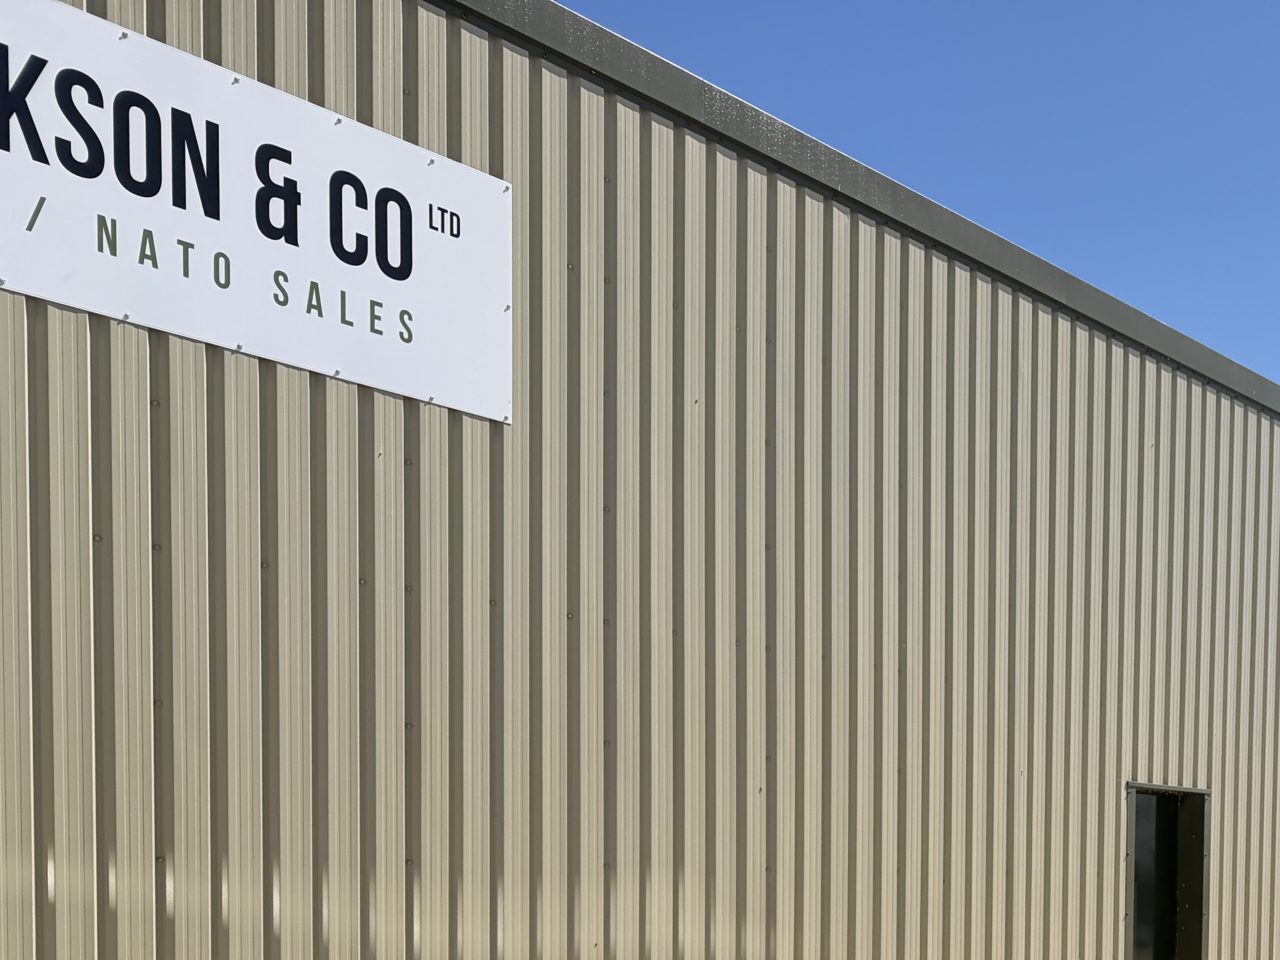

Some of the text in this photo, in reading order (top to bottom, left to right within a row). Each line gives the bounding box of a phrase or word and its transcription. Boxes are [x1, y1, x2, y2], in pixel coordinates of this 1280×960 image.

[0, 42, 461, 281] KSON & CO LTD
[96, 214, 231, 290] NATO
[273, 270, 414, 344] SALES
